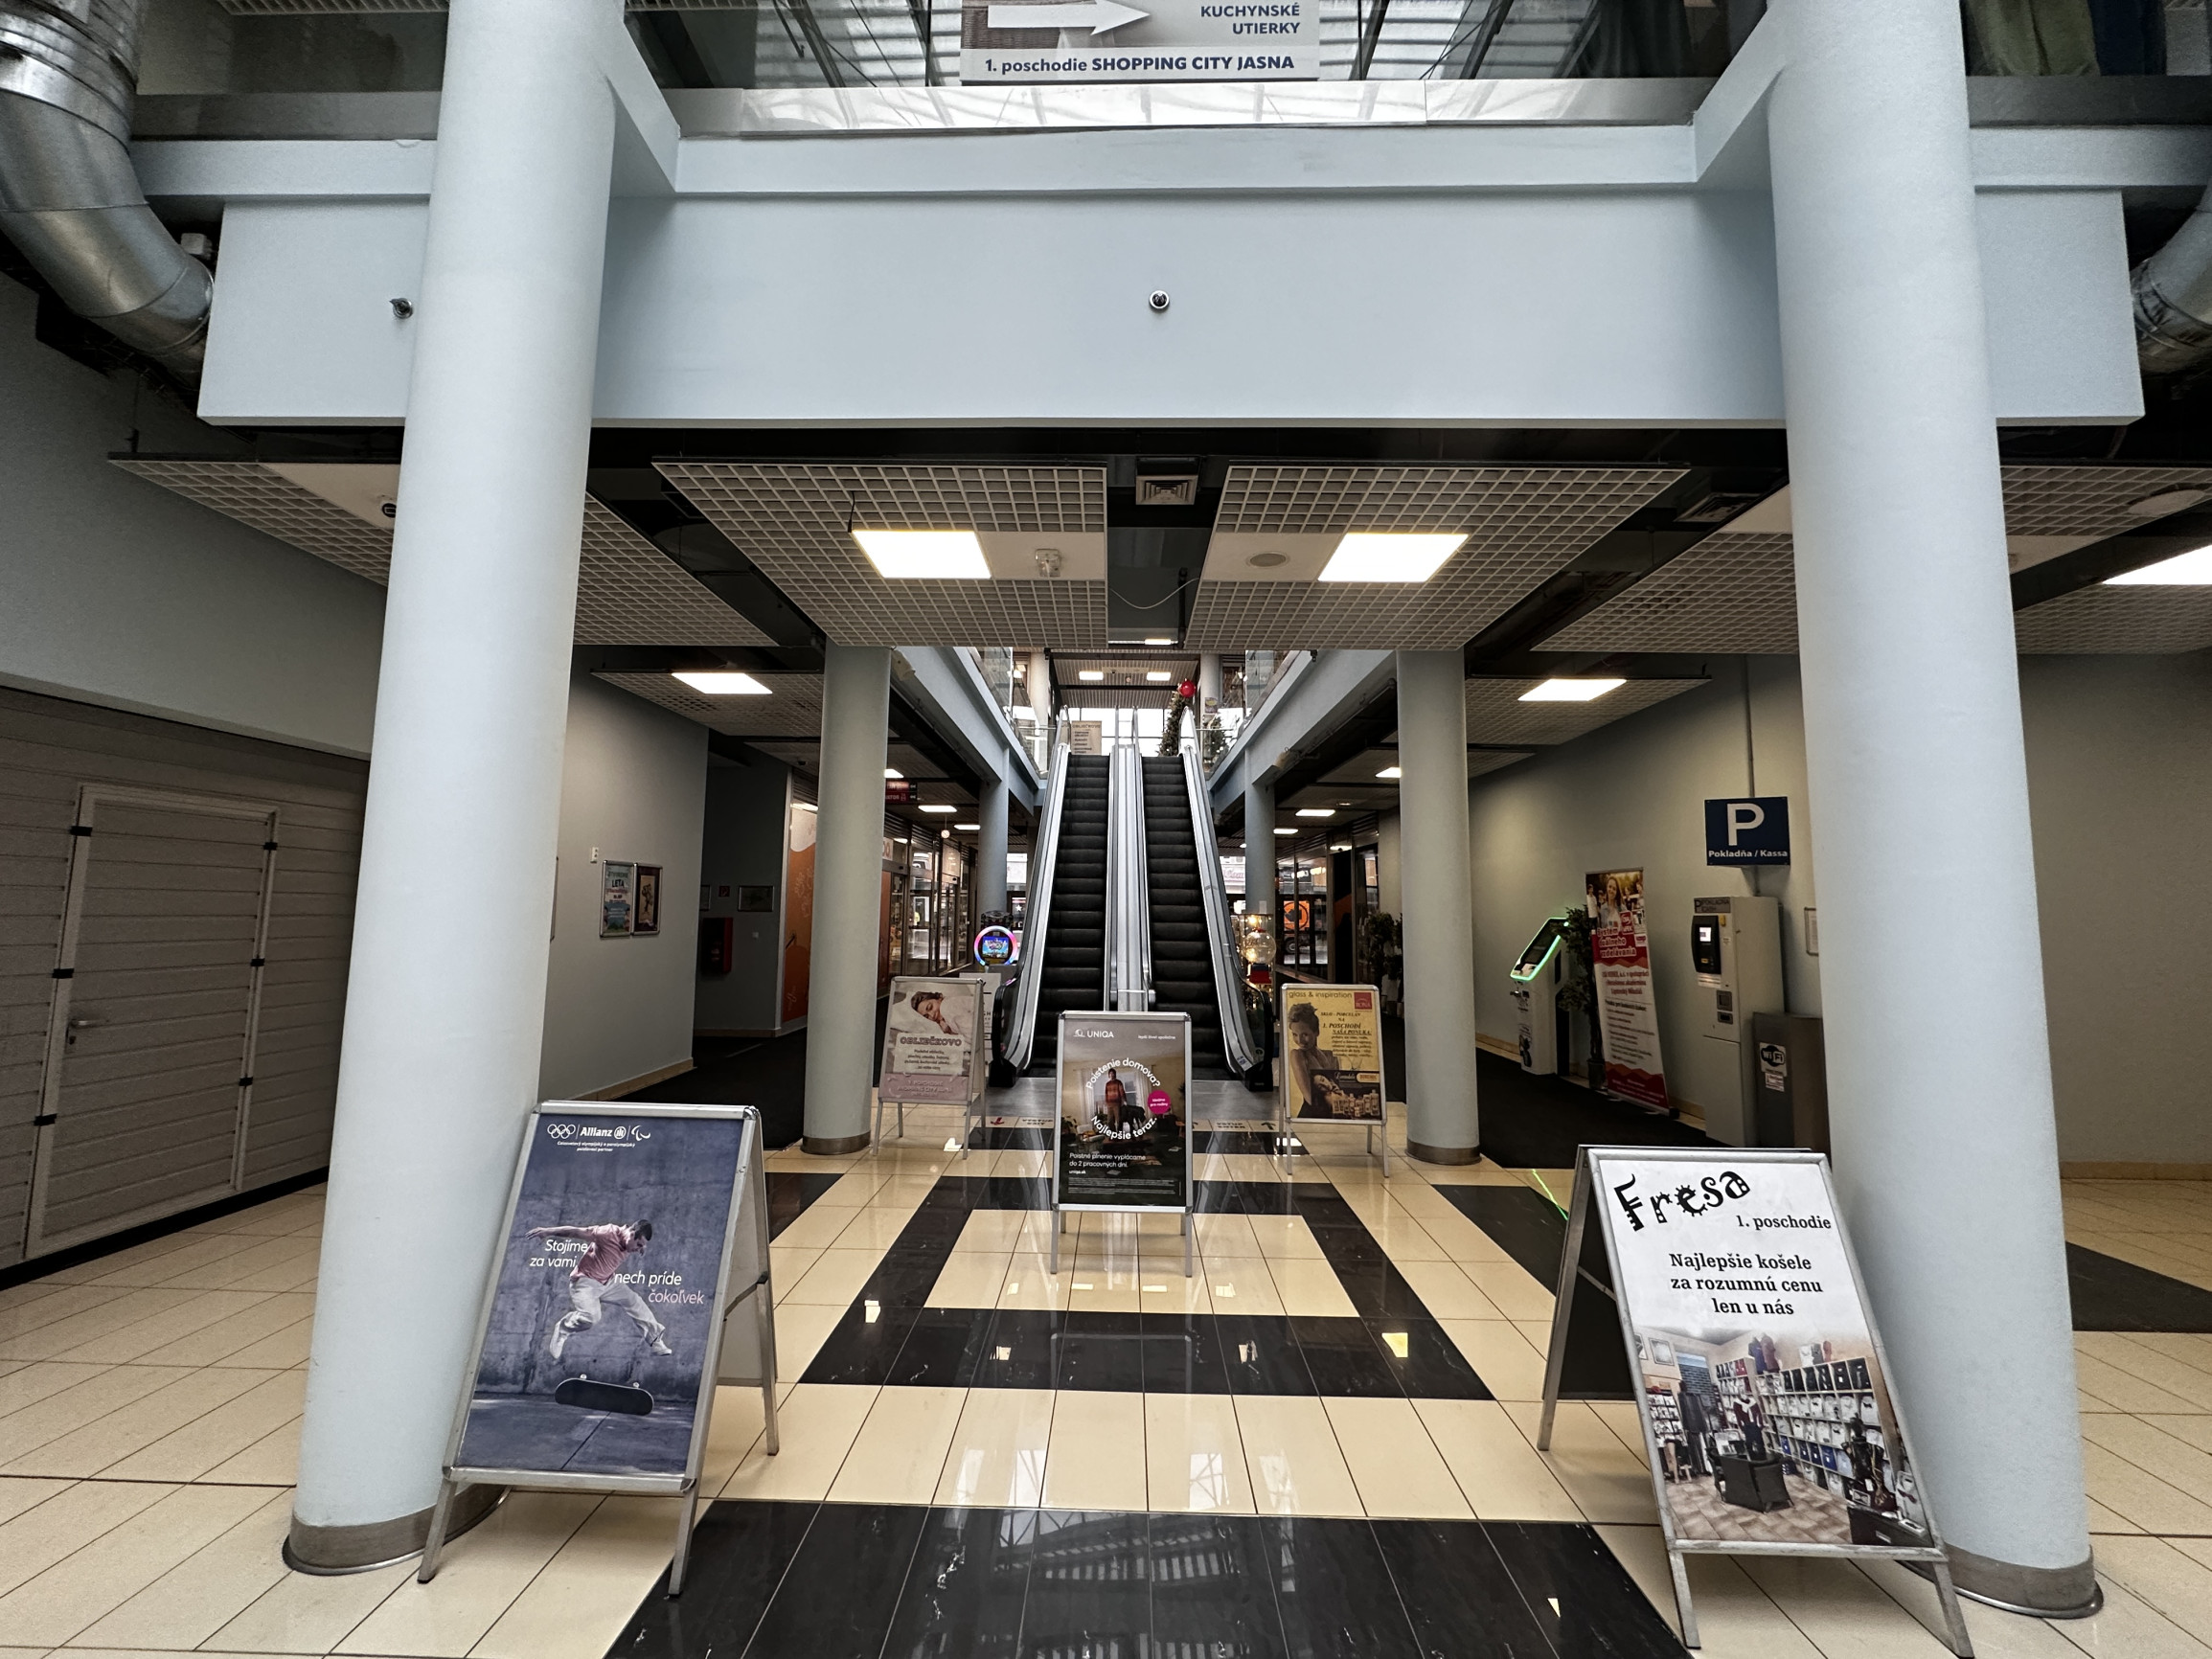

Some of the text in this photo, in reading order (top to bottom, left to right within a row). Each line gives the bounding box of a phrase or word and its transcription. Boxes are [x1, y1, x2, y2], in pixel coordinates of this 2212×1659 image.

[1200, 2, 1301, 18] KUCHYNSKÉ
[1232, 22, 1301, 35] UTIERKY
[985, 56, 1295, 75] 1. poschodie SHOPPING CITY JASNA
[1727, 803, 1765, 846] P
[1086, 1030, 1115, 1038] UNIQA
[1085, 1057, 1161, 1090] Poistenie domova?
[580, 1126, 613, 1137] Allianz
[1091, 1115, 1158, 1139] Najlepšie teraz.
[1613, 1170, 1751, 1232] Fresa
[1736, 1215, 1832, 1231] 1. poschodie
[544, 1239, 589, 1254] Stojíme
[530, 1258, 544, 1267] za
[1669, 1253, 1812, 1271] Najlepšie košele
[614, 1270, 682, 1286] nech príde
[1671, 1276, 1823, 1292] za rozumnú cenu
[648, 1288, 704, 1305] čokoľvek
[1711, 1298, 1794, 1314] len u nás
